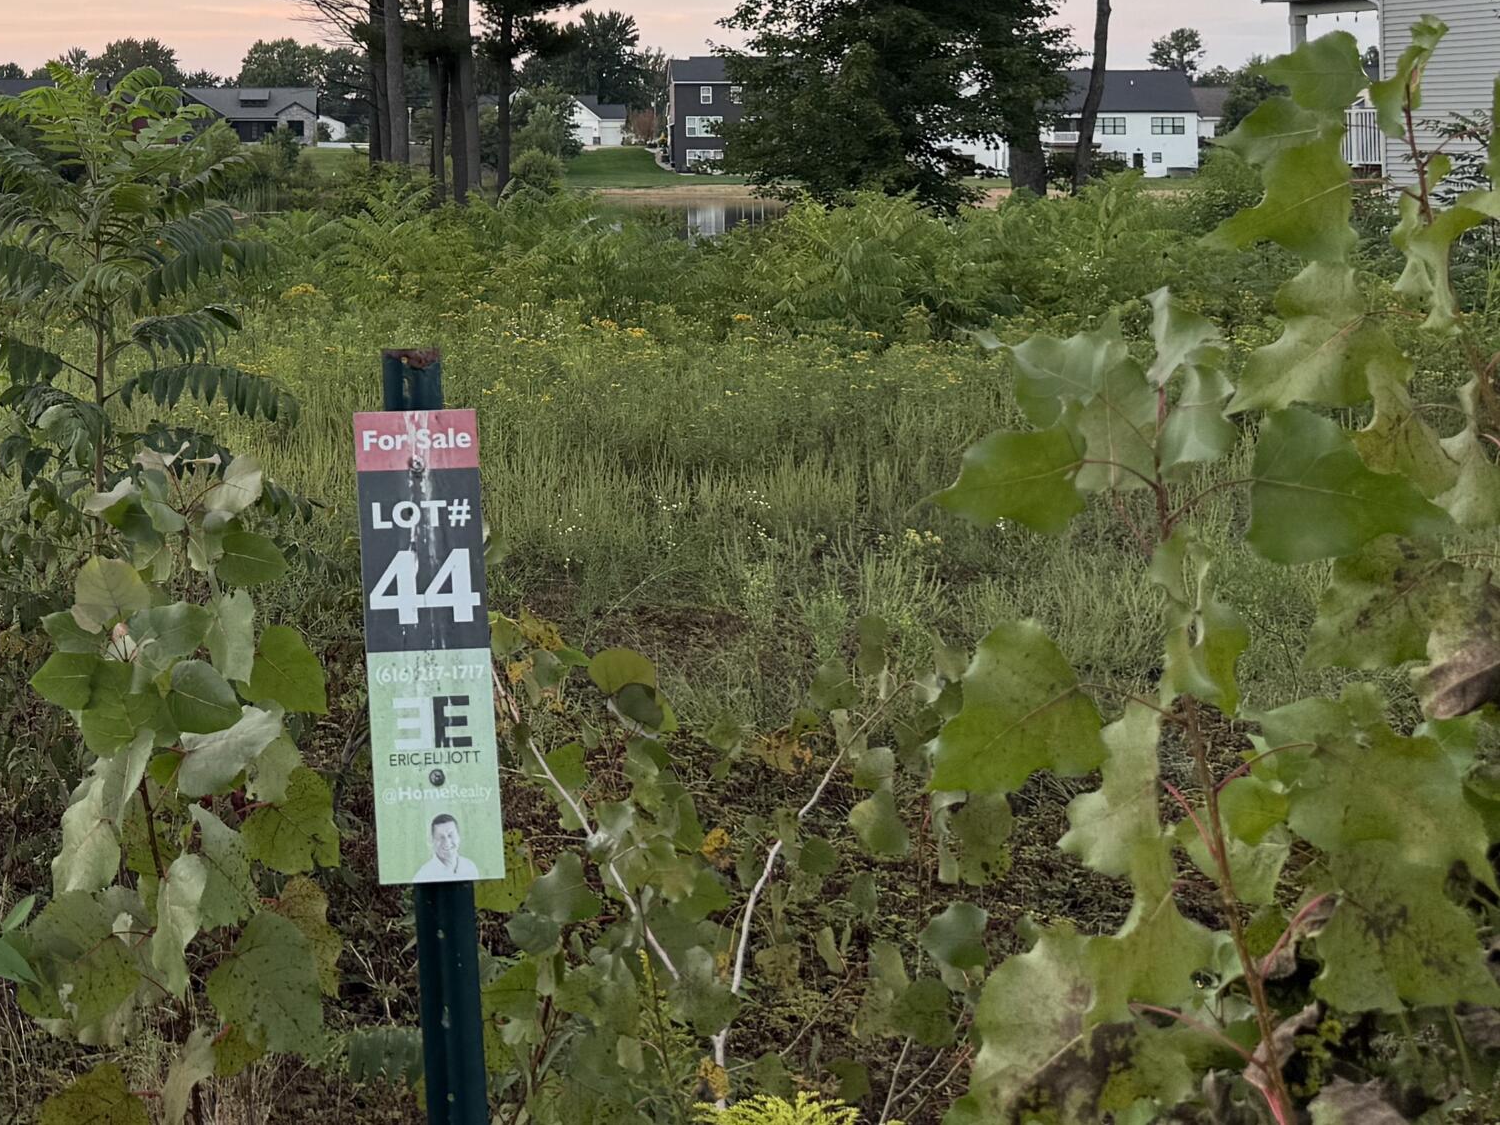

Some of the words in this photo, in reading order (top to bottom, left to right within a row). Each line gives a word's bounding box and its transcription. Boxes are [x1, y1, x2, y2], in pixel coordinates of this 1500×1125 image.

[362, 430, 407, 452] For
[415, 428, 472, 450] Sale
[371, 498, 471, 529] LOT#
[369, 548, 481, 625] 44
[376, 663, 414, 685] (616)
[389, 753, 420, 766] ERIC
